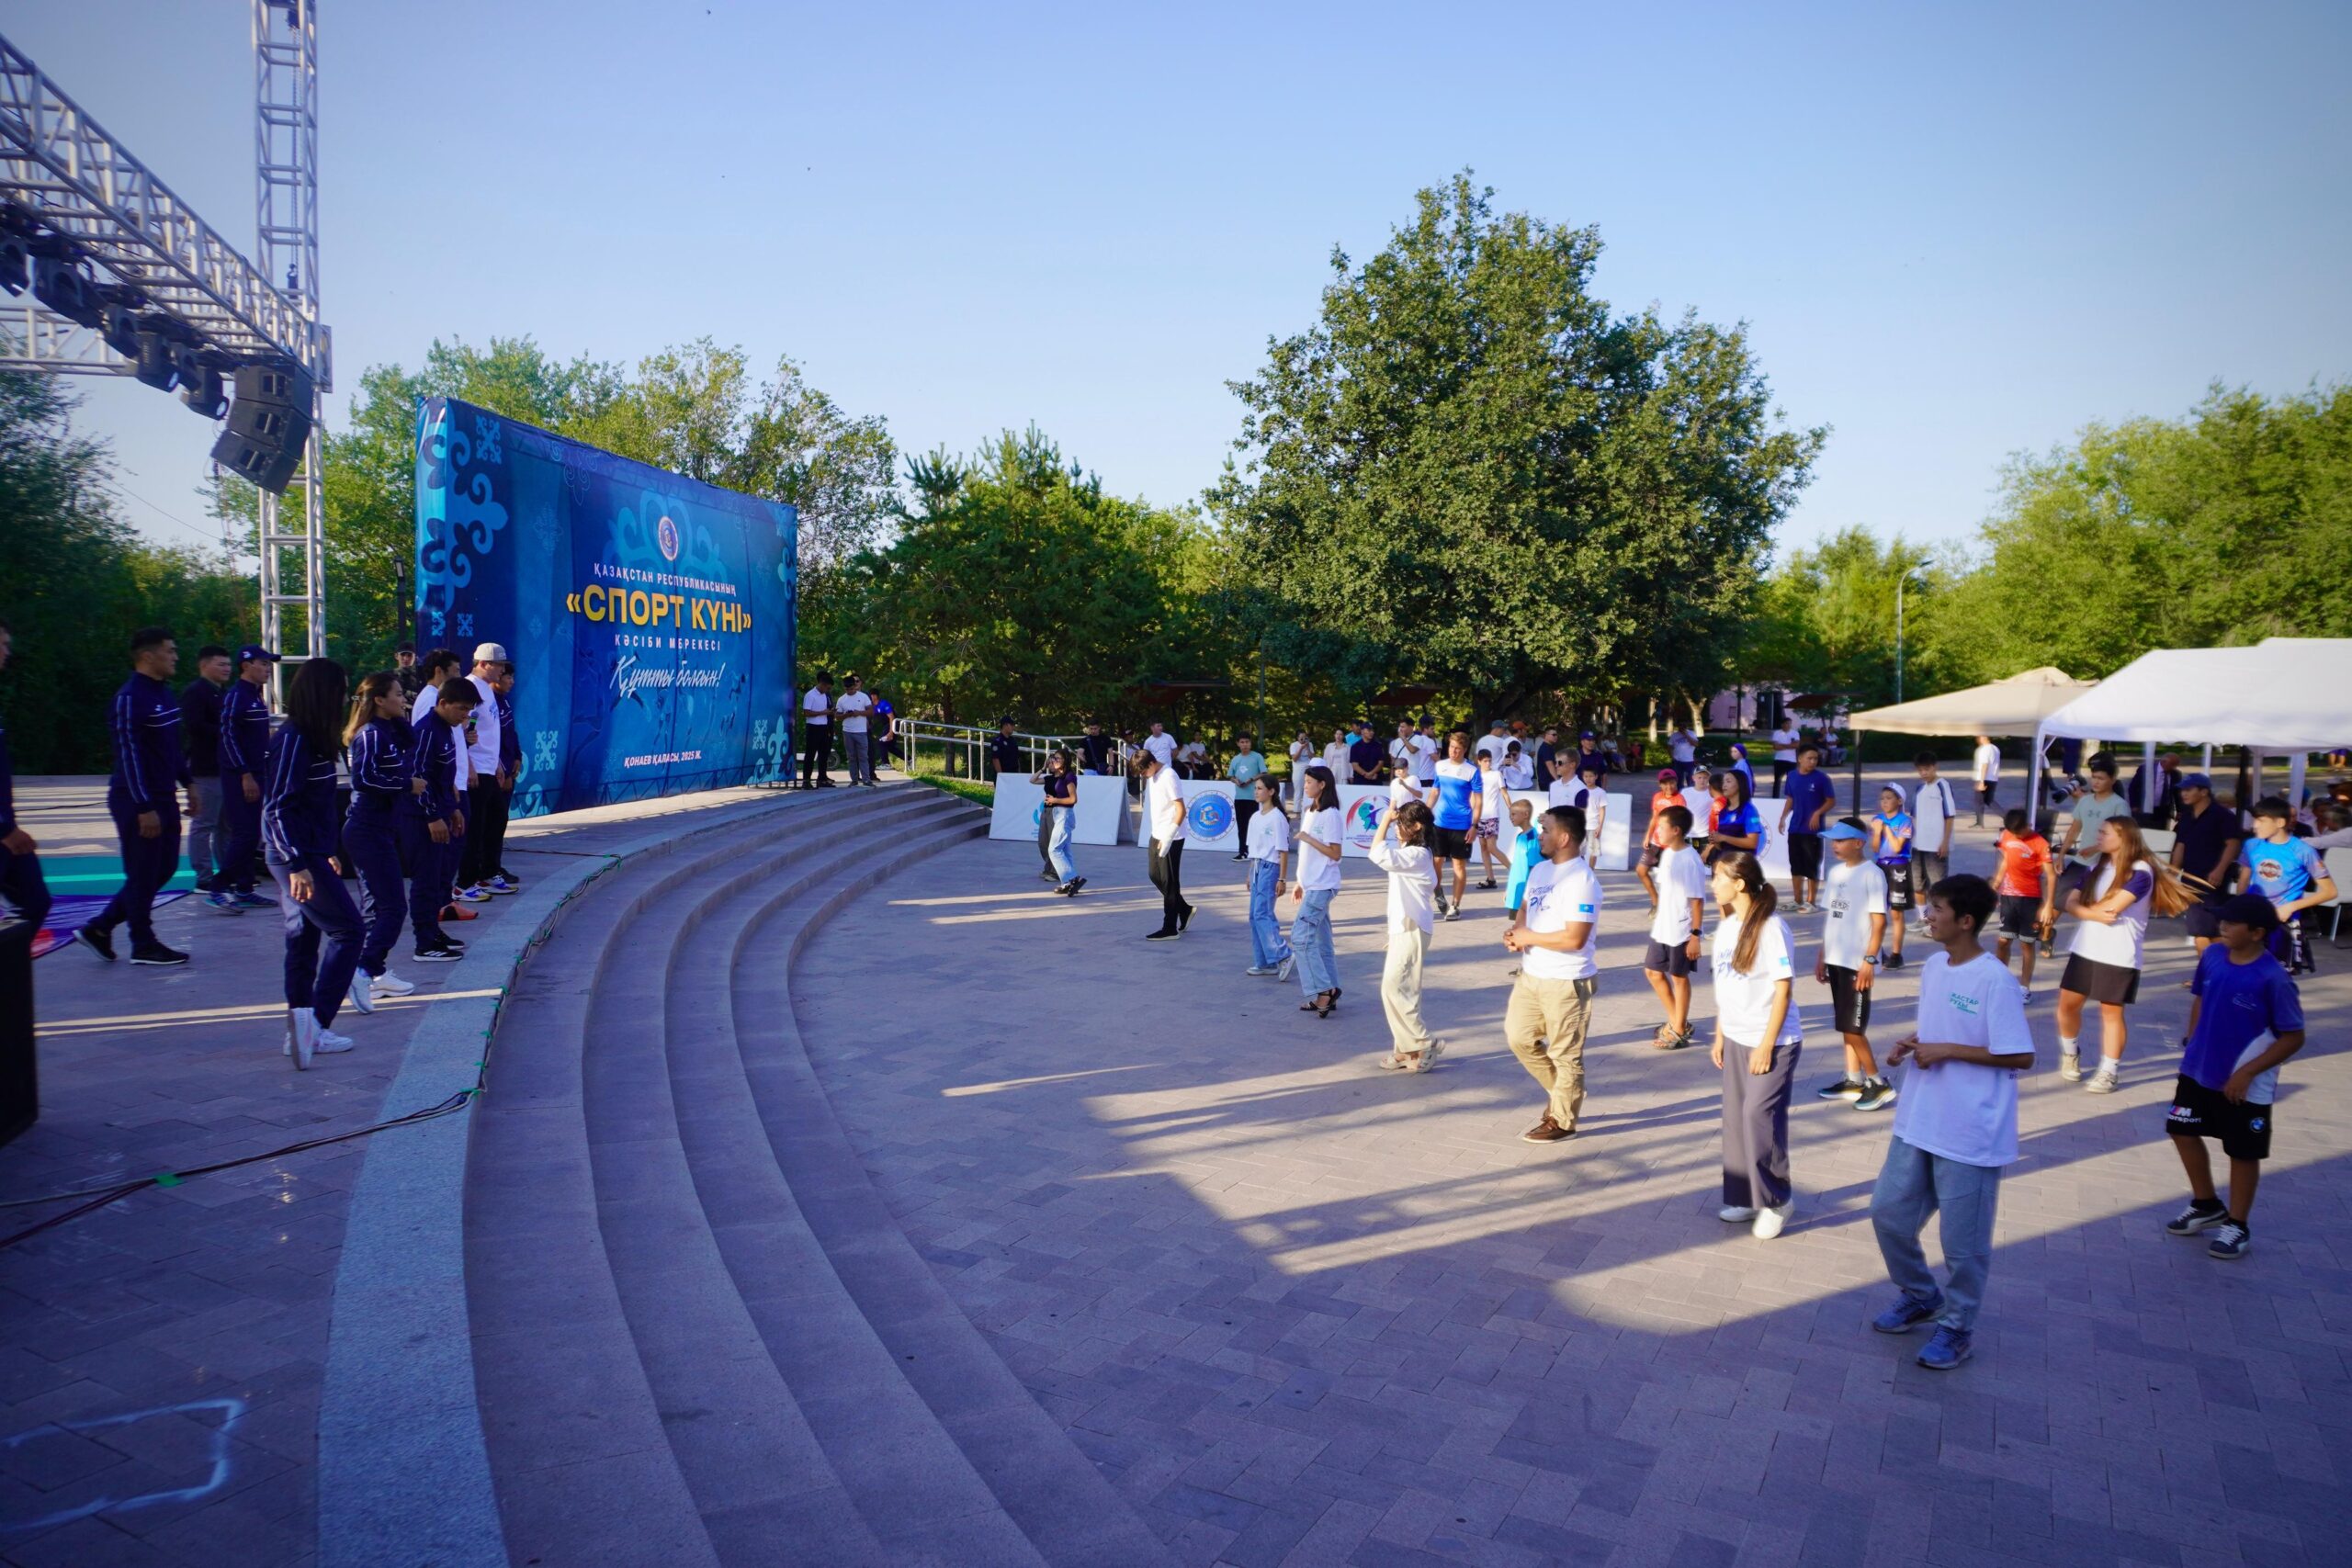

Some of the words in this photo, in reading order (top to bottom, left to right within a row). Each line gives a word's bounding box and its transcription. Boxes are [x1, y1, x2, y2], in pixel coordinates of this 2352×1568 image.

[594, 562, 654, 582] ҚАЗАҚСТАН
[657, 573, 737, 597] РЕСПУБЛИКАСЫНЫҢ
[566, 584, 684, 628] «СПОРТ
[691, 597, 752, 633] КҮНІ»
[615, 634, 662, 649] КӘСІБИ
[669, 637, 720, 651] МЕРЕКЕСІ
[609, 655, 675, 699] Құтты
[675, 660, 727, 688] болсын!
[624, 755, 652, 769] ҚОНАЕВ
[652, 751, 680, 766] ҚАЛАСЫ,
[681, 750, 695, 761] 2025
